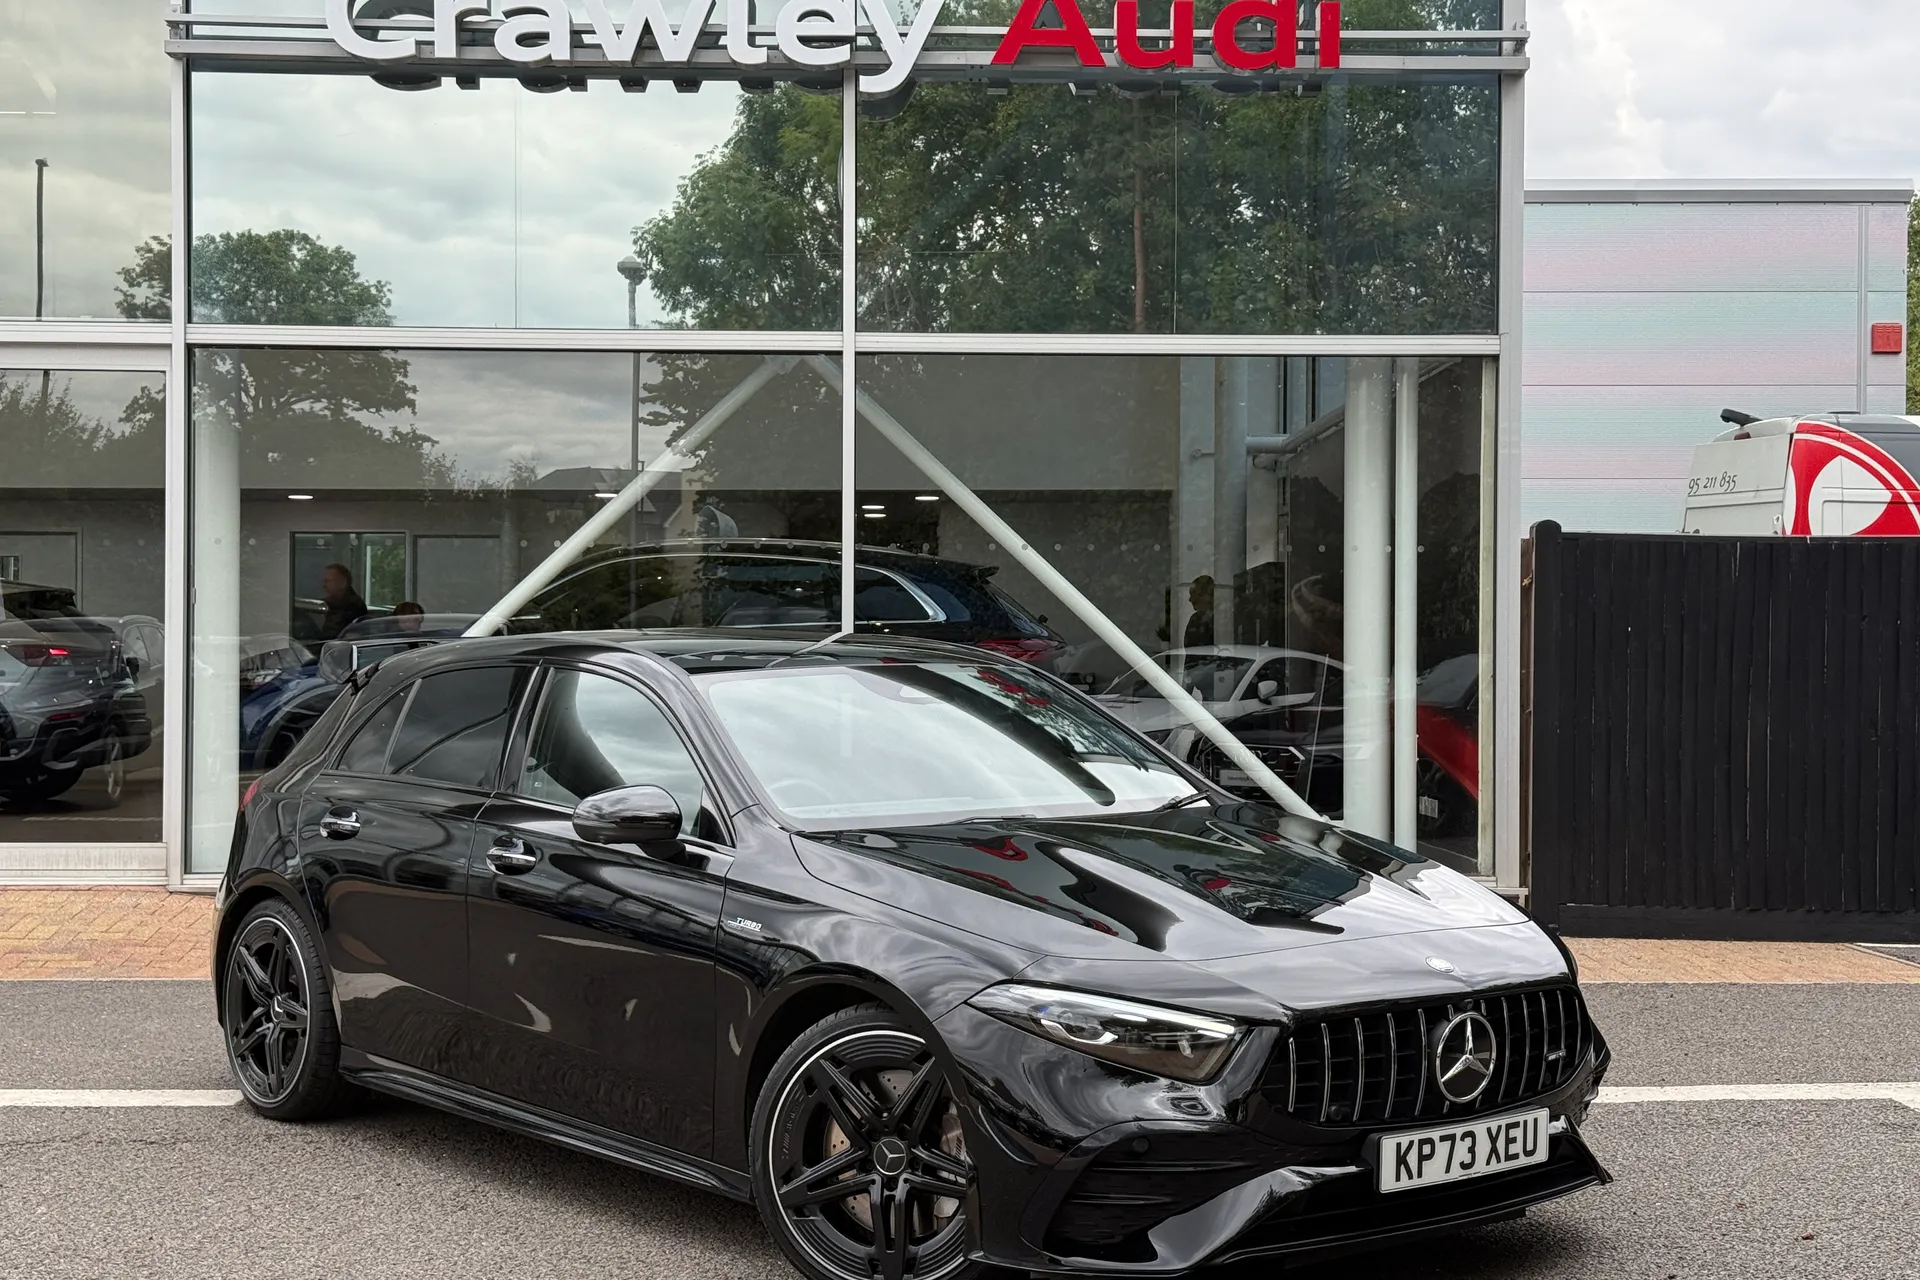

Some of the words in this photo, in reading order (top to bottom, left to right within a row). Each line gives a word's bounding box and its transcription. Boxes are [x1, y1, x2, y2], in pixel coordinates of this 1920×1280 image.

[325, 0, 945, 93] Crawley
[990, 0, 1341, 70] Audi
[1687, 477, 1701, 495] 95
[1703, 476, 1718, 489] 211
[1719, 470, 1738, 492] 835
[736, 917, 762, 930] TURBO
[1394, 1130, 1477, 1183] KP73
[1485, 1117, 1539, 1167] XEU
